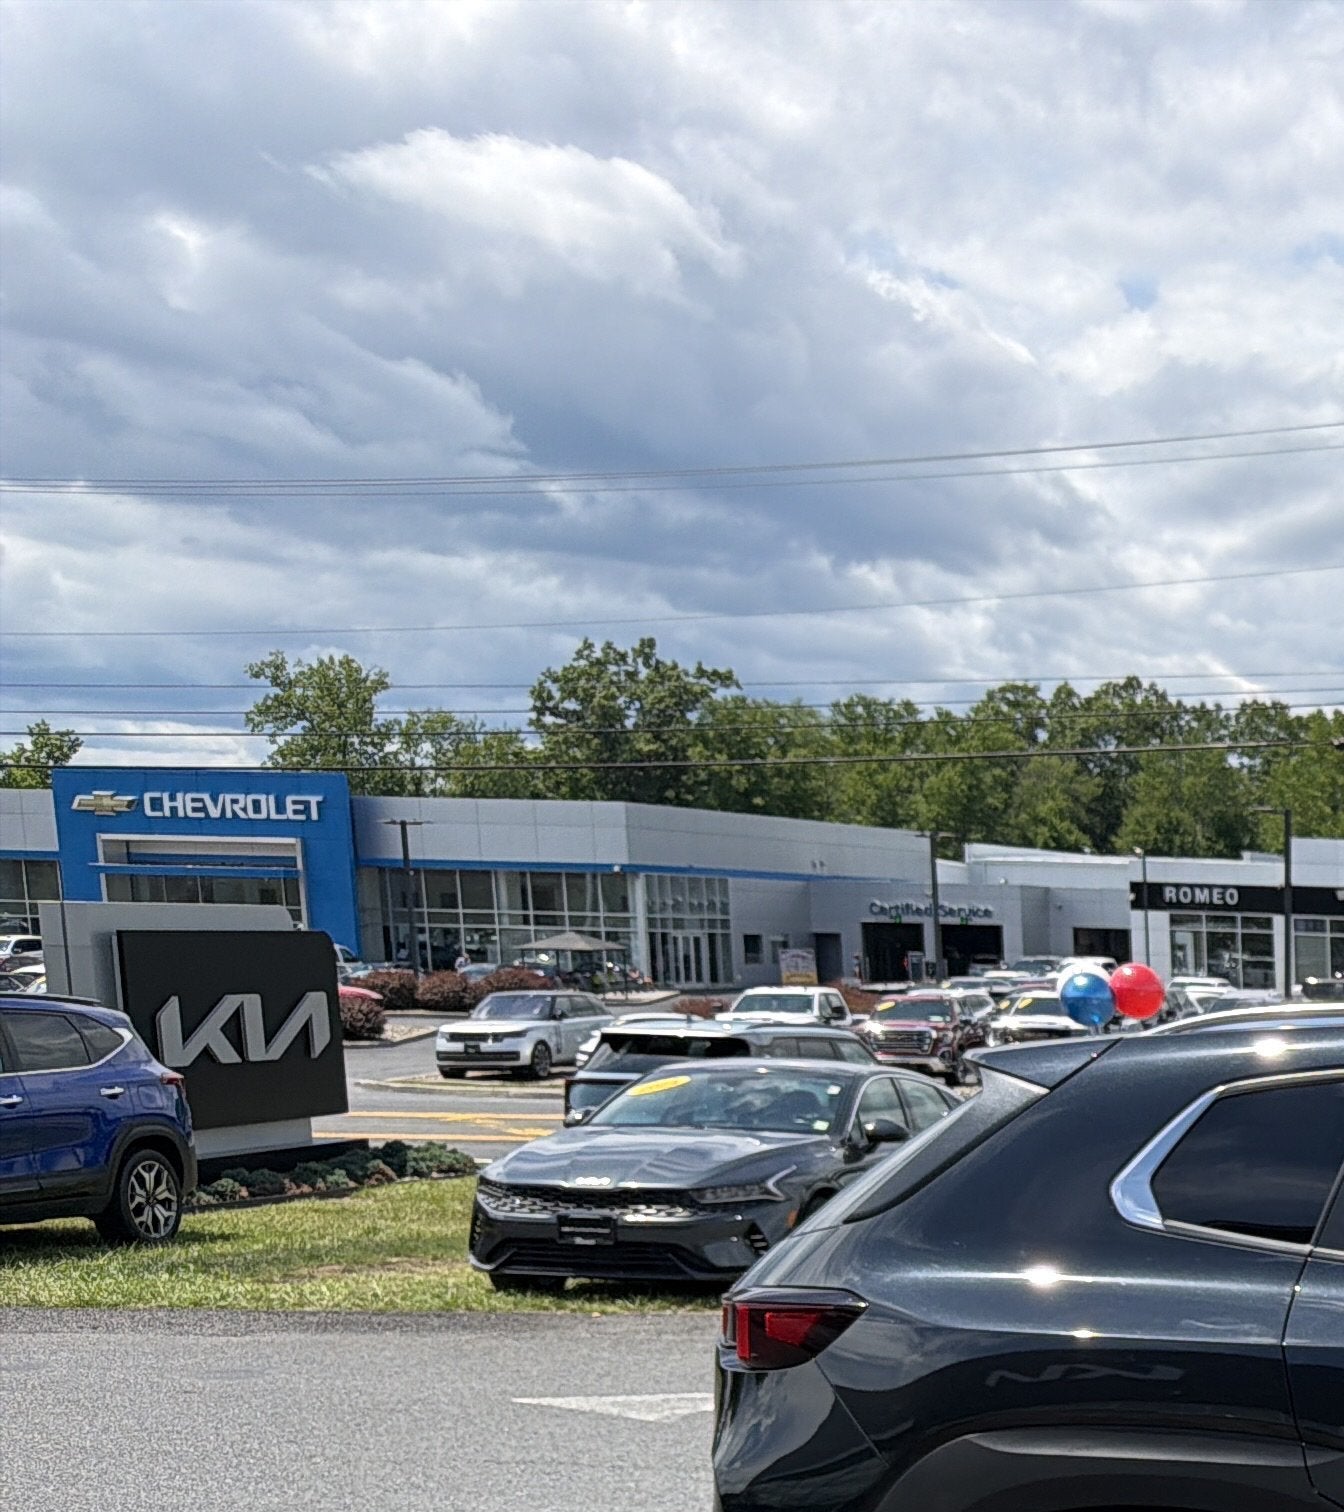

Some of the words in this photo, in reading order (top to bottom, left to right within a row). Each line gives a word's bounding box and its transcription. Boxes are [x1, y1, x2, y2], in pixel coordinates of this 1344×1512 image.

[143, 791, 324, 821] CHEVROLET
[1163, 886, 1240, 906] ROMEO
[869, 902, 934, 919] Certified
[937, 903, 993, 919] Service
